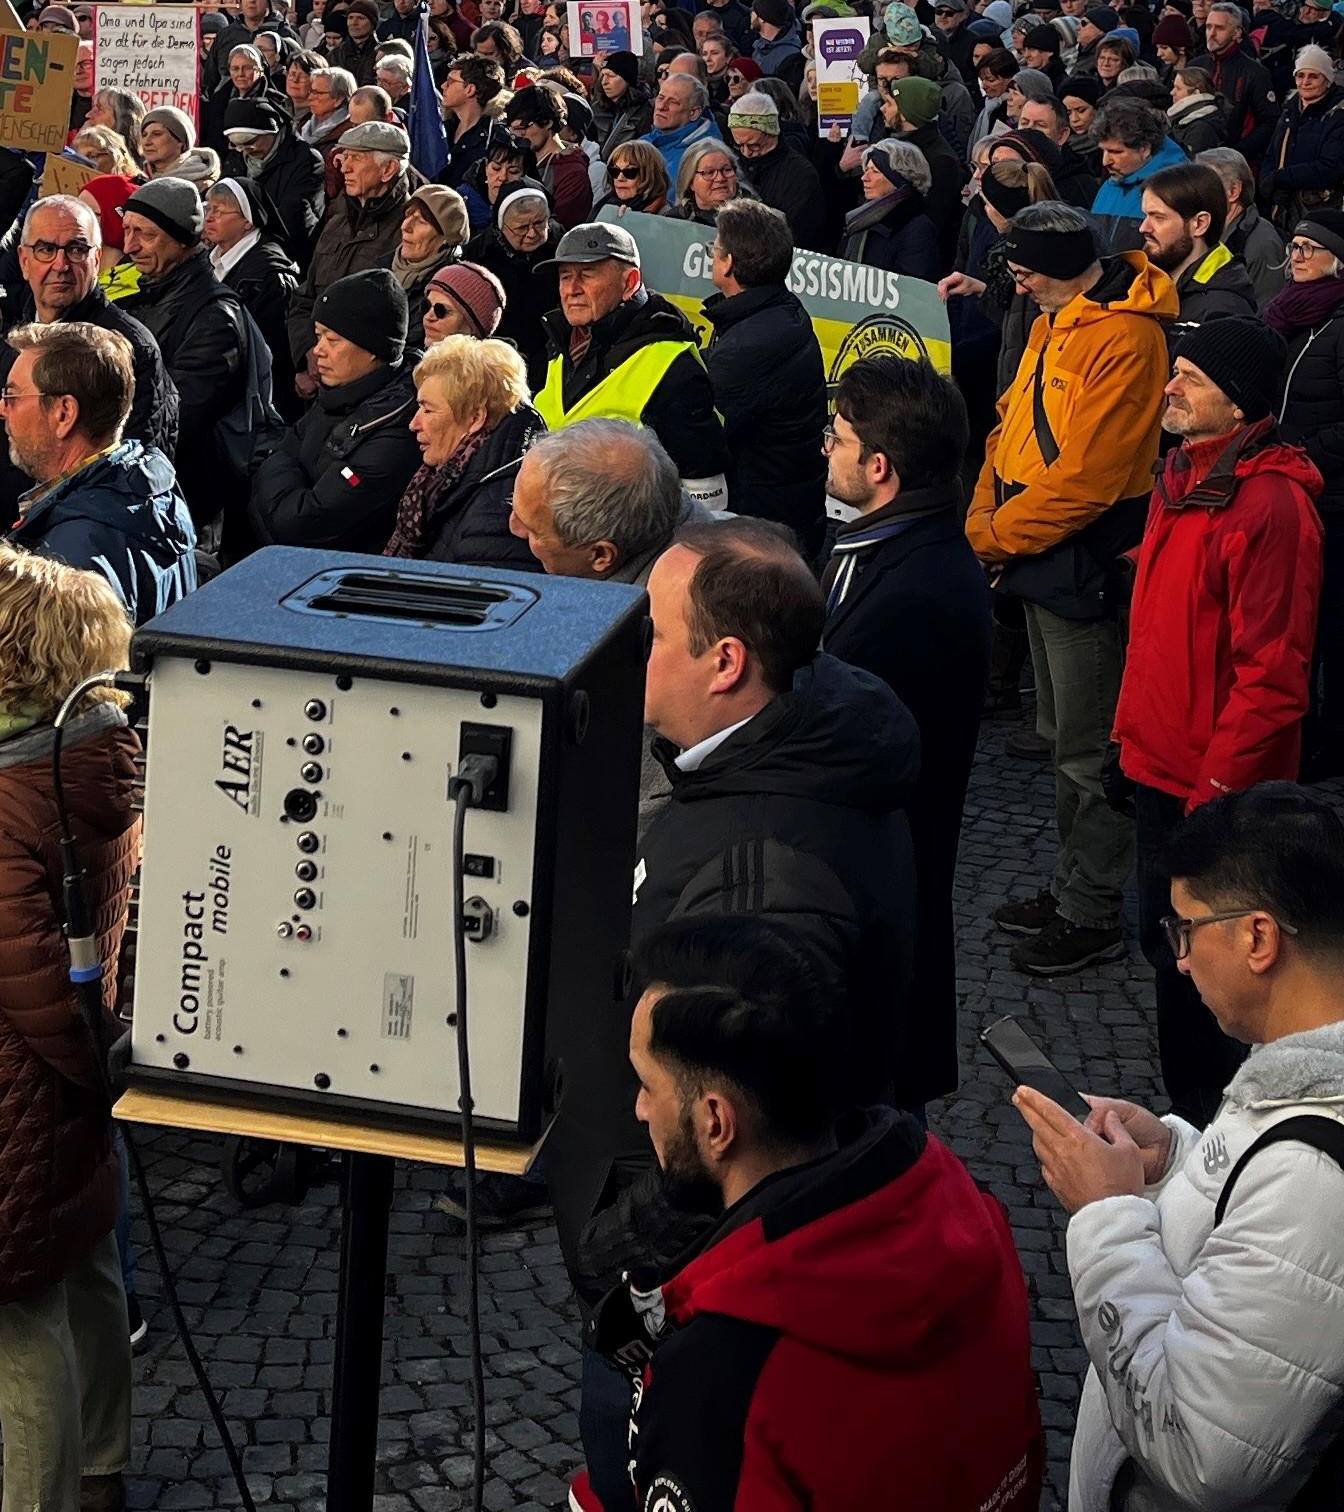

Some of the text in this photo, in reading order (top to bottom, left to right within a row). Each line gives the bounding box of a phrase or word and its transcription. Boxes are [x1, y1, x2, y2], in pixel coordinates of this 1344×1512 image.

[99, 11, 193, 32] Oma und Opa sind
[99, 37, 112, 47] zu
[115, 32, 129, 47] alt
[132, 32, 148, 47] für
[151, 36, 165, 48] die
[100, 54, 165, 74] sagen jedoch
[100, 73, 180, 92] aus Erfahrung
[853, 326, 911, 359] ZUSAMMEN
[690, 488, 724, 501] ORDNER
[214, 725, 254, 815] AER
[208, 844, 232, 934] mobile
[173, 890, 208, 1035] Compact
[204, 969, 215, 1040] battery powered
[217, 979, 225, 1006] guitar
[215, 1007, 223, 1041] acoustic
